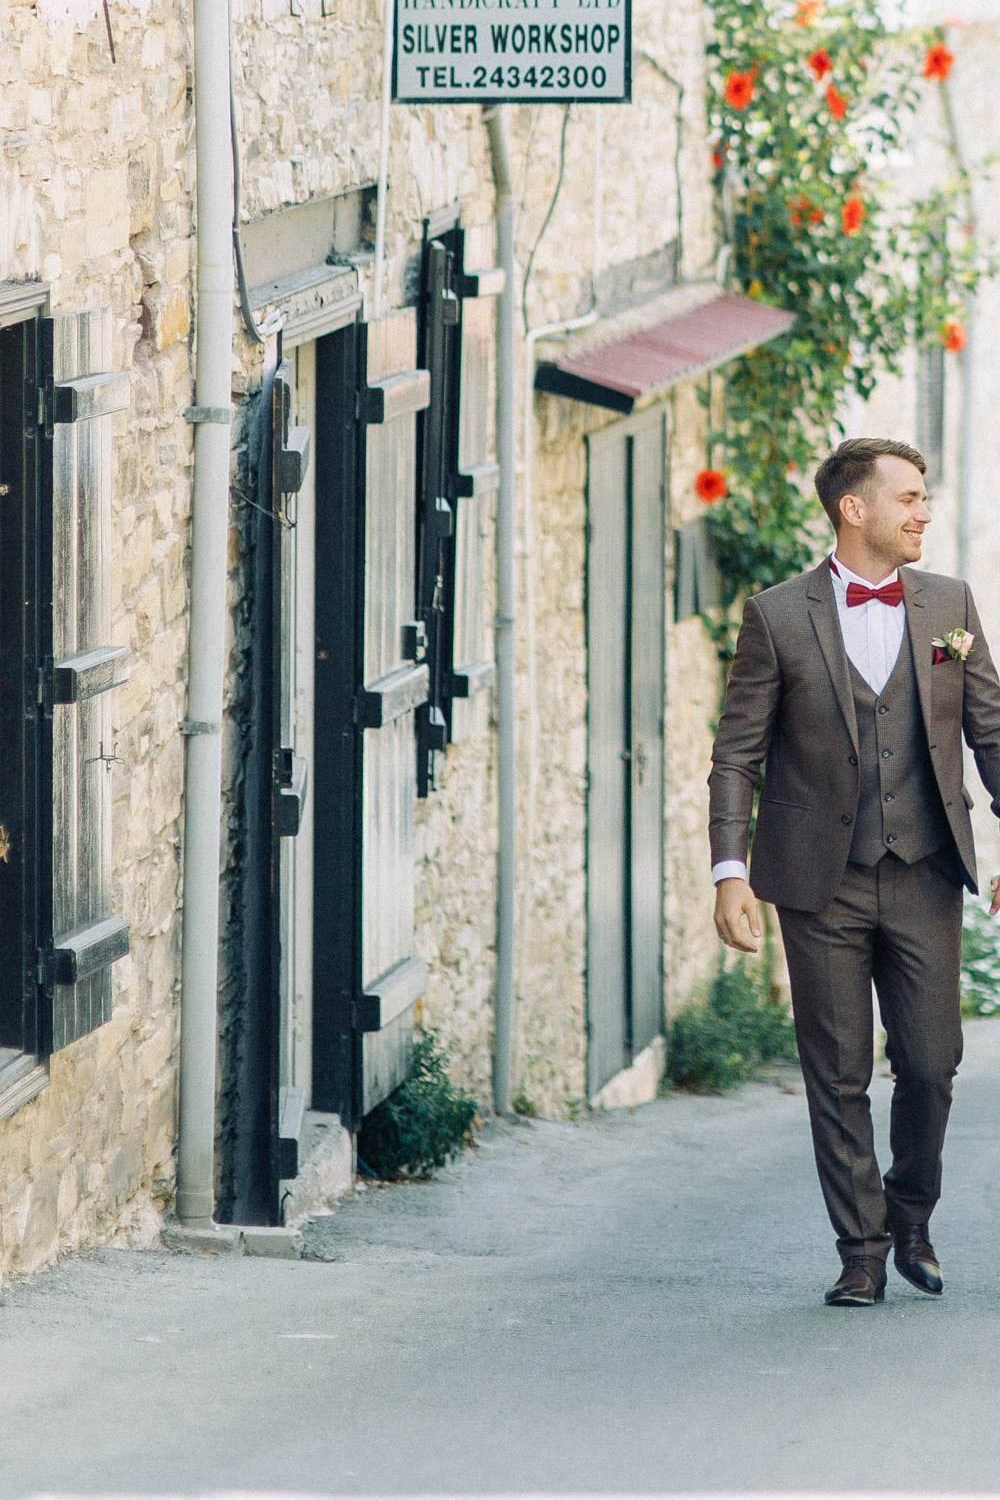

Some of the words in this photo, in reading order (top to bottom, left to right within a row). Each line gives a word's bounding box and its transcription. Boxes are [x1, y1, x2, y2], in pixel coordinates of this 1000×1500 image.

[402, 24, 478, 54] SILVER
[490, 24, 621, 54] WORKSHOP
[416, 66, 607, 88] TEL.24342300
